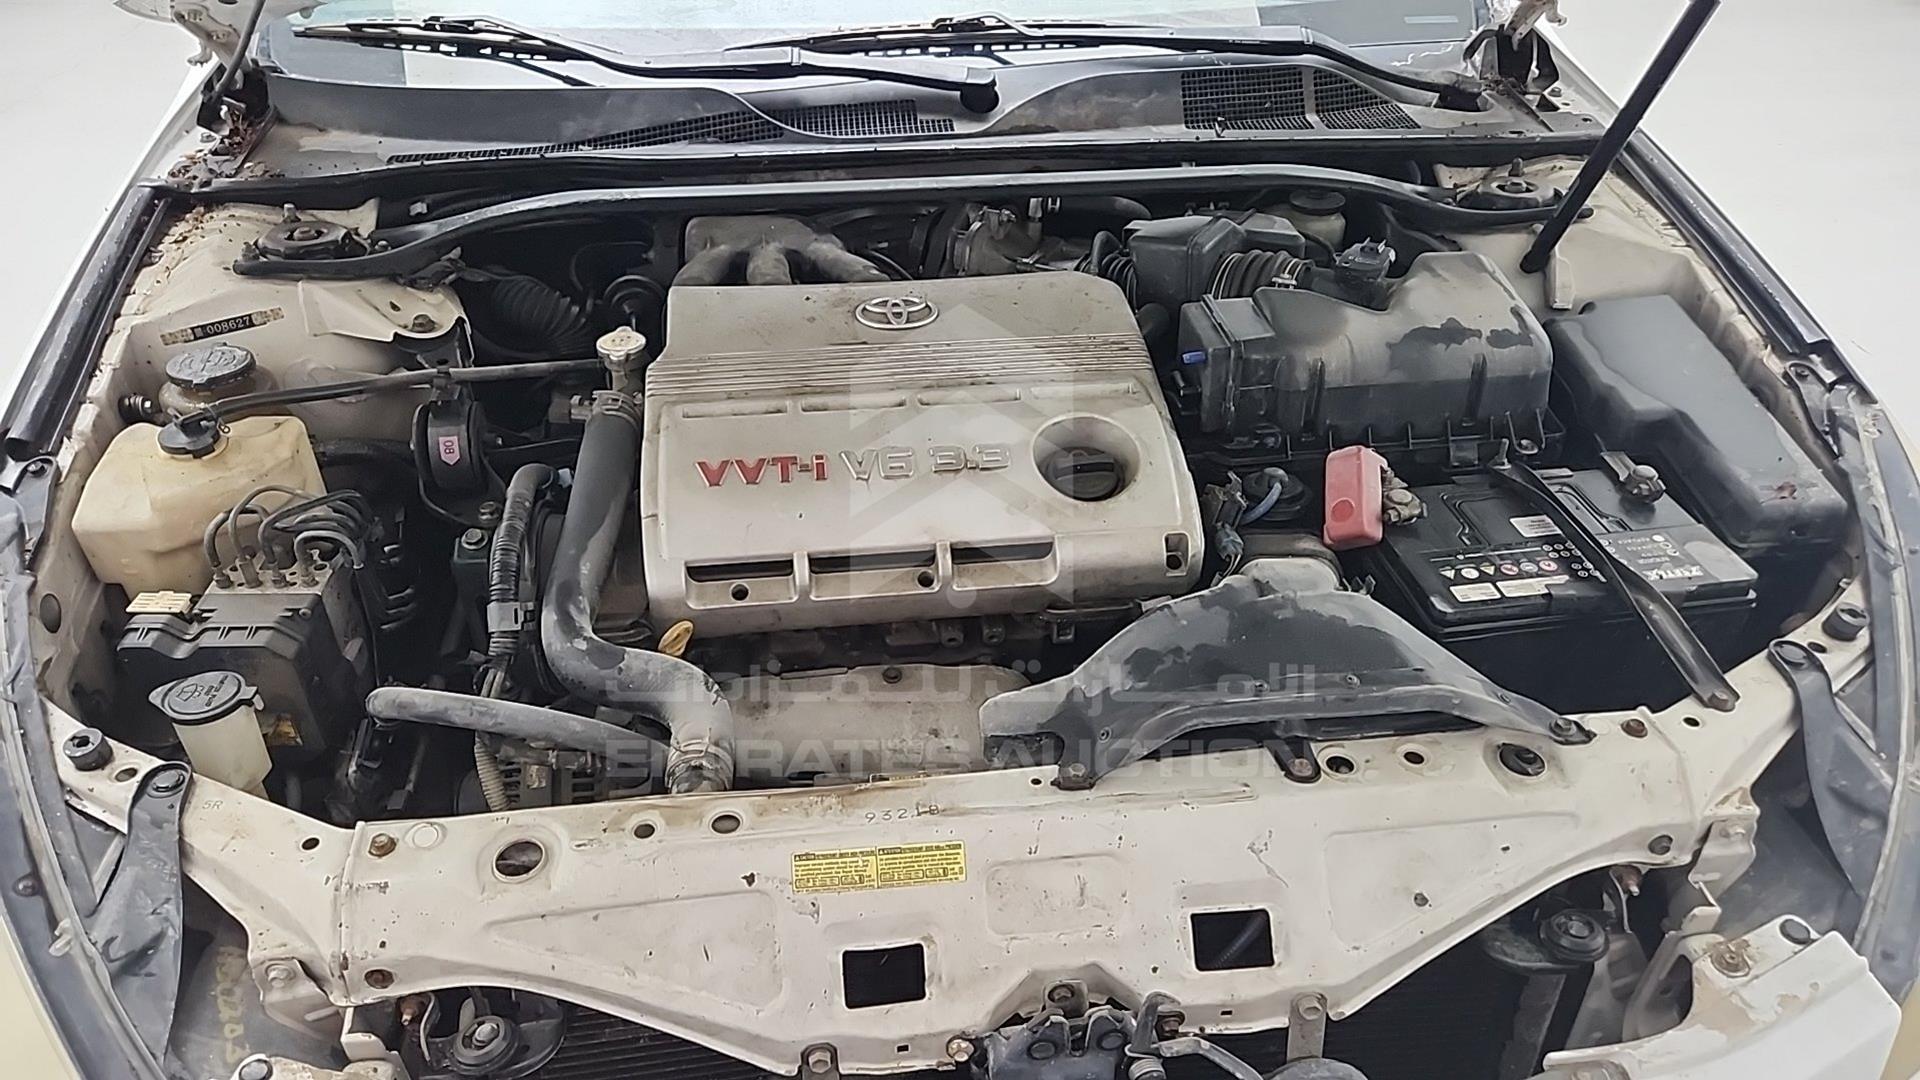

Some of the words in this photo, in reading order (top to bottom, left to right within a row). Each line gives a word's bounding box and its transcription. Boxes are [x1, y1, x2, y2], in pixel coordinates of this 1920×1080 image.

[206, 316, 251, 335] 008627
[695, 454, 829, 487] VVT-i
[840, 447, 915, 480] V6
[928, 444, 1010, 474] 3.3
